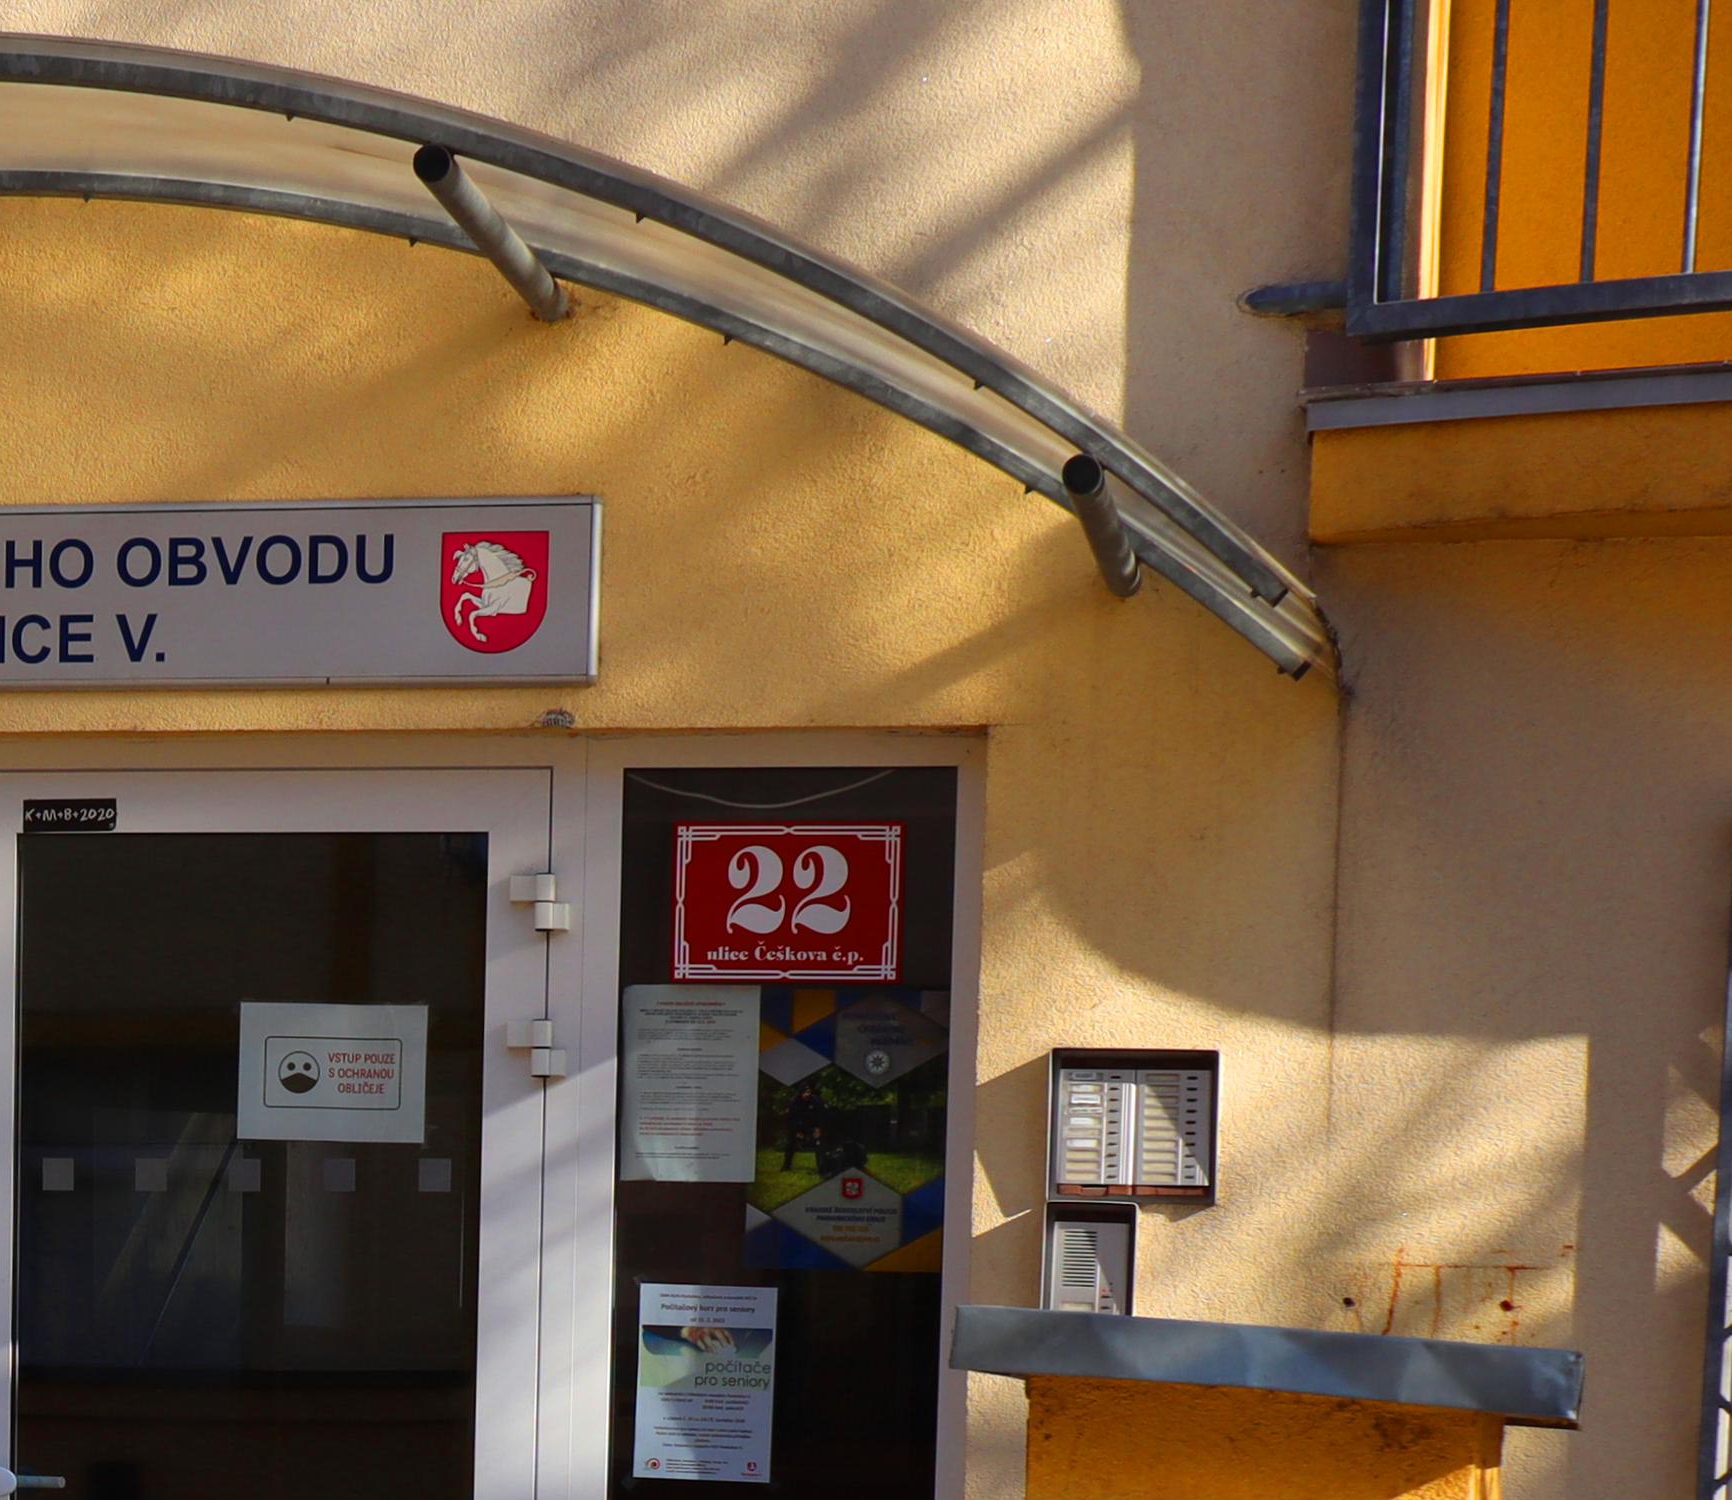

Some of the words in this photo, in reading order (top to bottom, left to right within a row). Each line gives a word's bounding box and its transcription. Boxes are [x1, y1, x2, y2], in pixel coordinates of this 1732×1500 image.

[115, 534, 396, 589] OBVODU
[115, 614, 166, 664] V.
[726, 844, 851, 935] 22
[706, 947, 749, 962] ulice
[754, 941, 828, 962] Češkova
[833, 945, 864, 965] č.p.
[327, 1052, 362, 1064] VSTUP
[364, 1053, 396, 1065] POUZE
[328, 1068, 335, 1078] S
[338, 1069, 395, 1080] OCHRANOU
[338, 1081, 386, 1095] OBLIČEJE
[705, 1359, 771, 1377] počítače
[694, 1376, 719, 1389] pro
[722, 1375, 771, 1390] seniory
